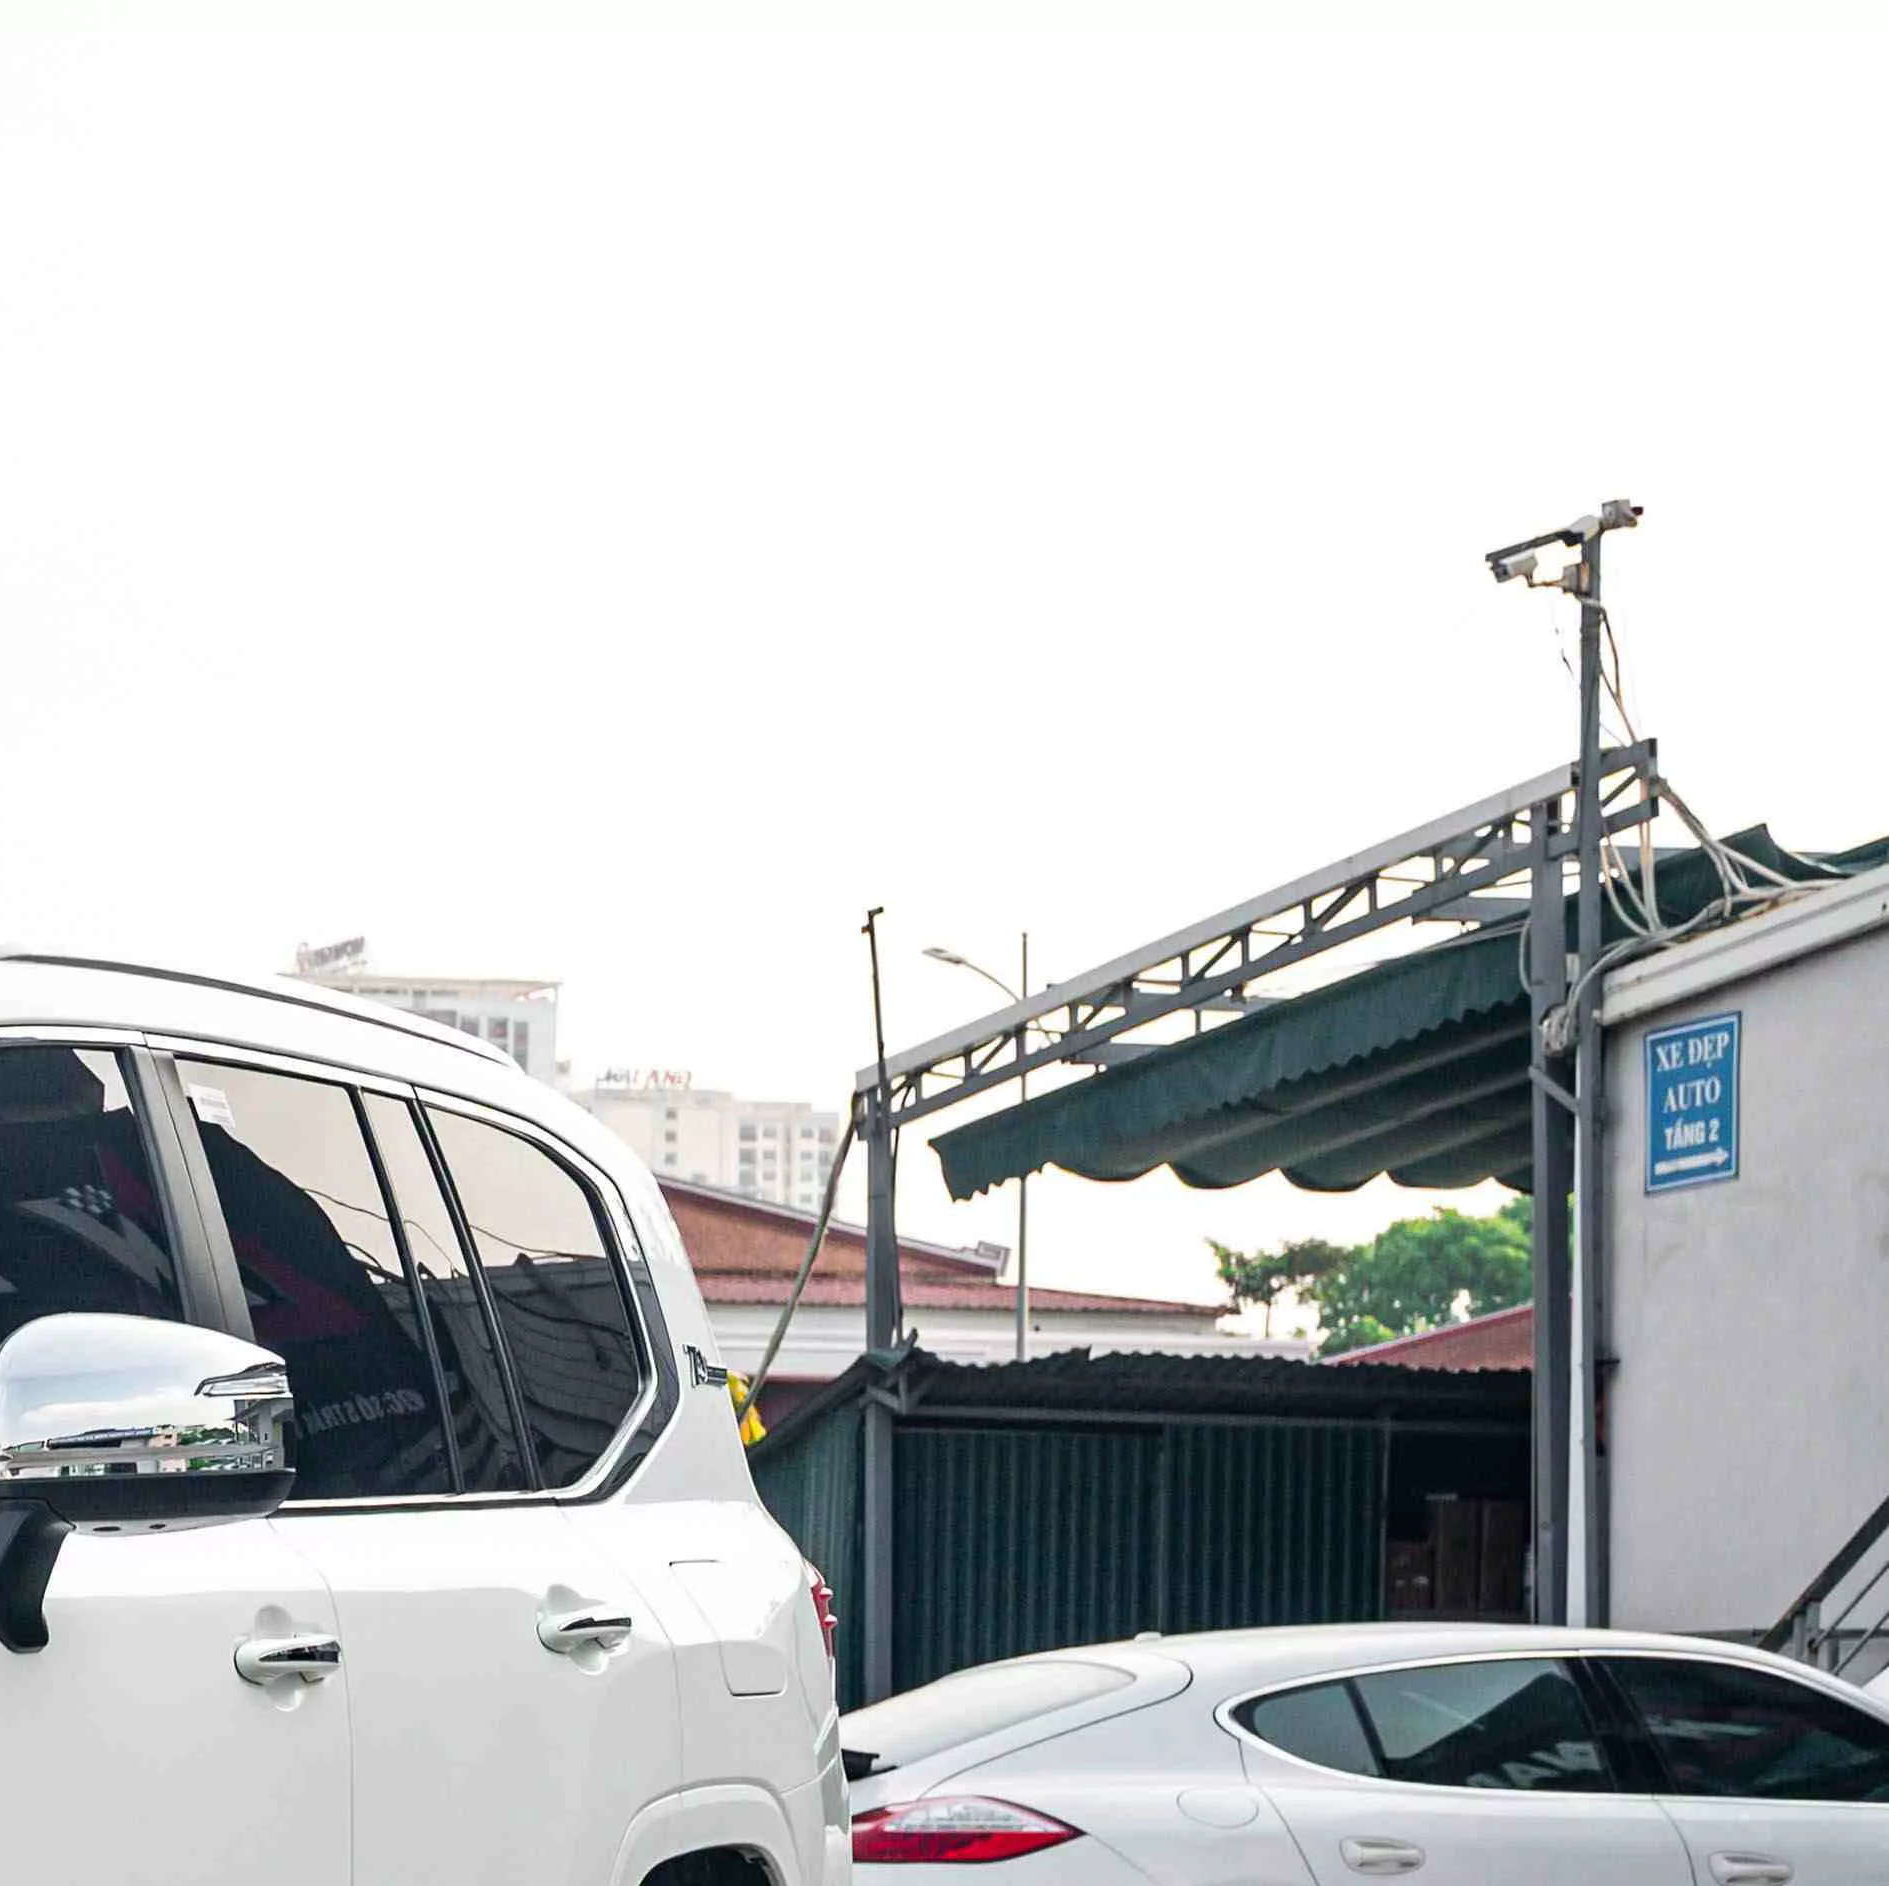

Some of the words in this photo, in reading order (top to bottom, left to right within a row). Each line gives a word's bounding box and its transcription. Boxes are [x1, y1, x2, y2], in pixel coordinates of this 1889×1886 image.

[1656, 1040, 1684, 1073] XE
[1687, 1031, 1730, 1070] ĐẸP
[1662, 1075, 1722, 1114] AUTO
[1708, 1117, 1721, 1143] 2
